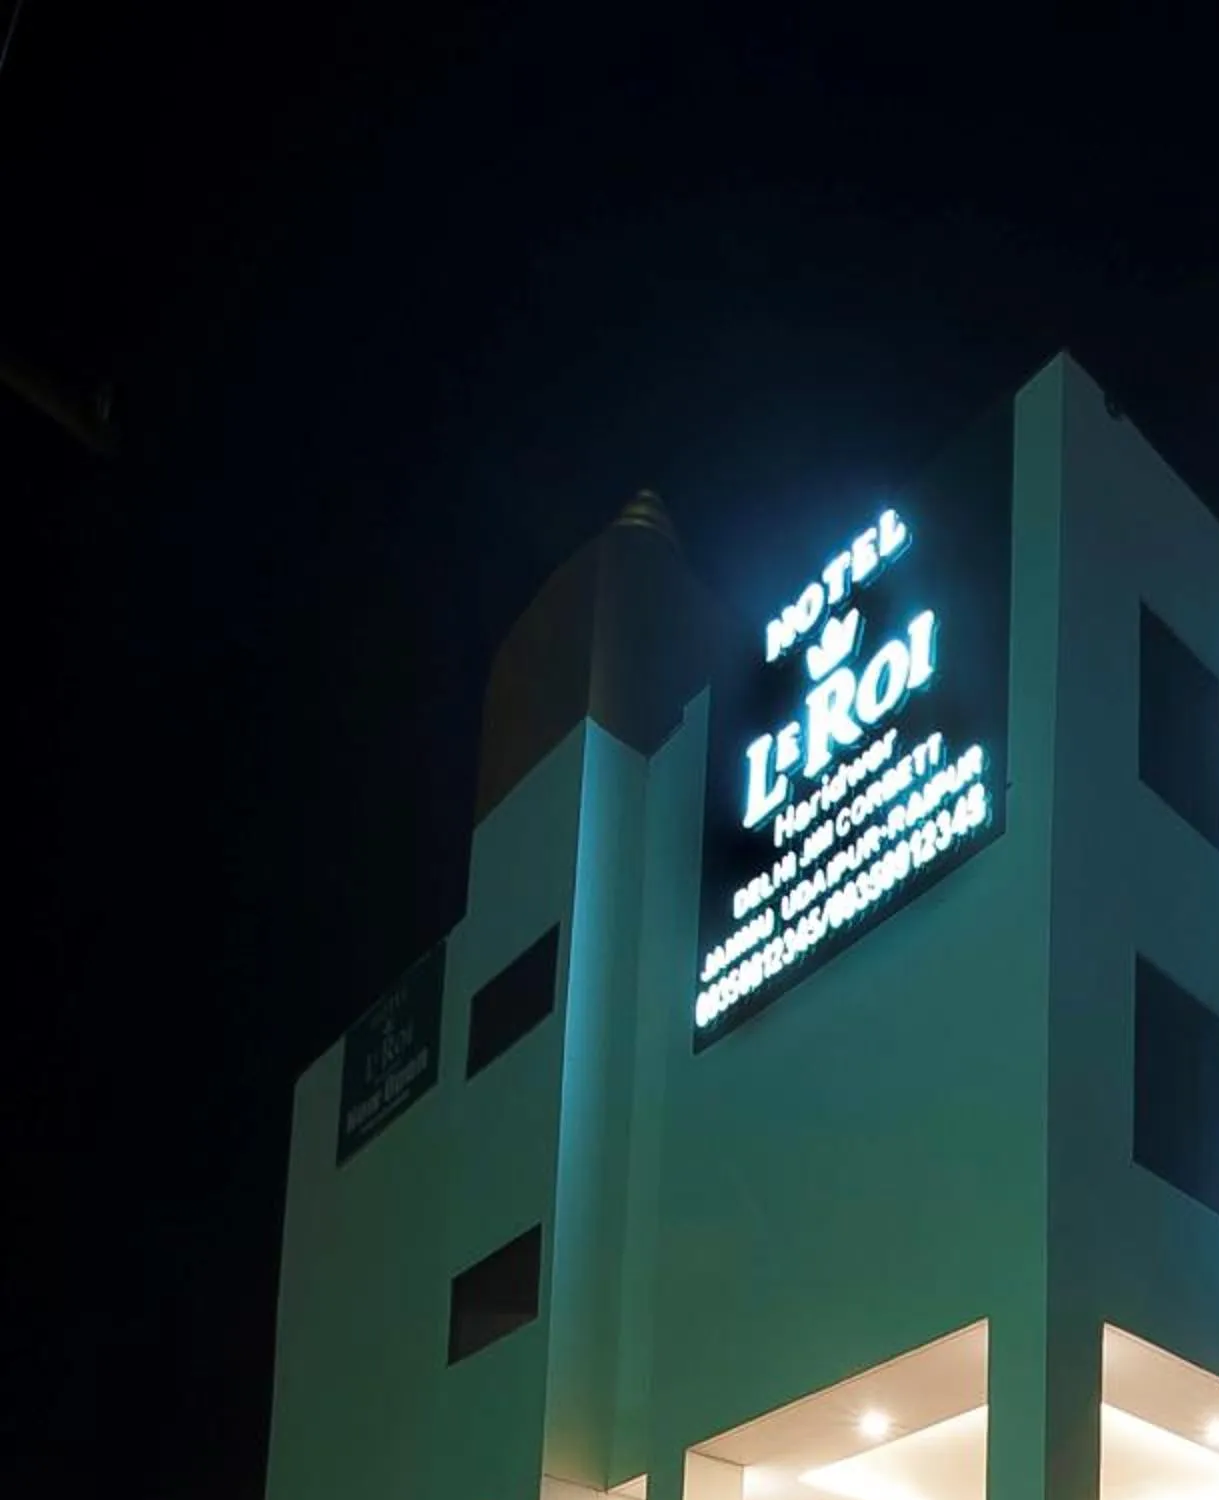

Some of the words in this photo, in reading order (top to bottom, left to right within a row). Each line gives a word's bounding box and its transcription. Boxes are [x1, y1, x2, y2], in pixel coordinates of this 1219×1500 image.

[766, 509, 907, 662] HOTEL
[743, 721, 801, 828] LE
[803, 609, 934, 778] ROI
[774, 728, 897, 847] Haridwar
[733, 851, 797, 919] DELHI
[836, 732, 942, 837] CORBETT
[700, 907, 775, 982] JAMMU
